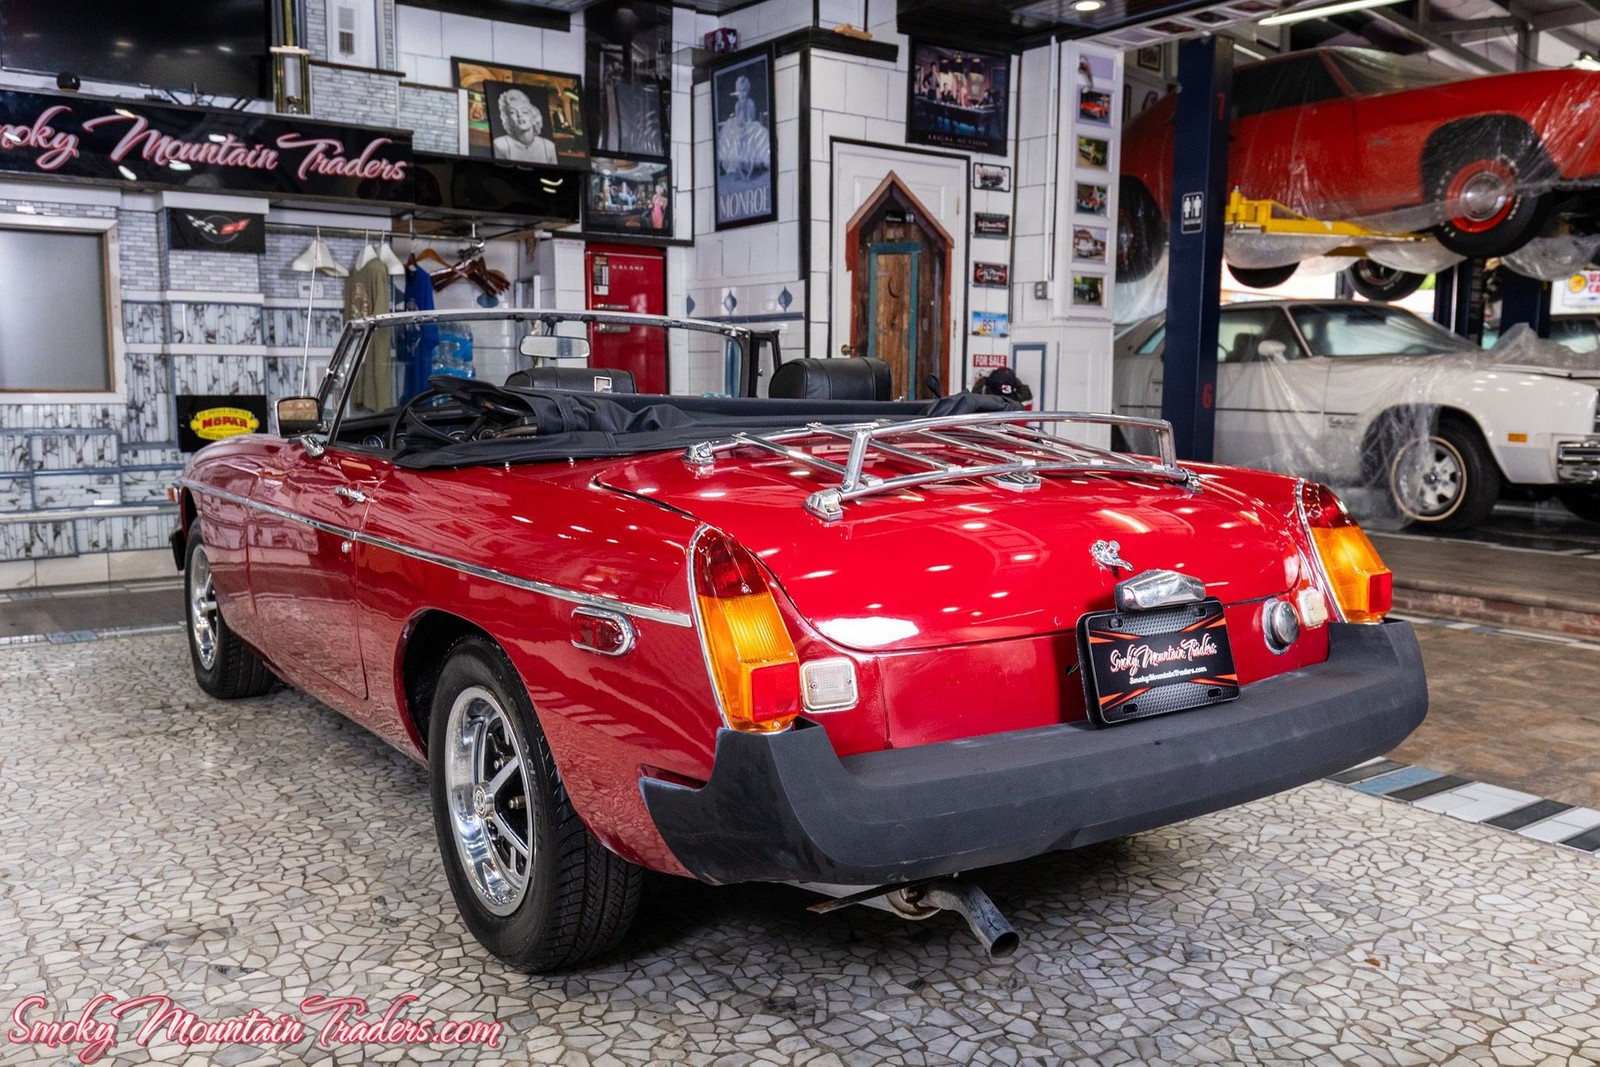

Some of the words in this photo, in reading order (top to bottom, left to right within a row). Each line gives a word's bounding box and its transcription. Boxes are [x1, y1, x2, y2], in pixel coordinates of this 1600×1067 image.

[82, 113, 279, 171] Mountain
[276, 133, 406, 180] Traders
[720, 187, 770, 218] MONROE
[975, 355, 988, 366] FOR
[989, 355, 1005, 367] SALE
[1001, 384, 1012, 394] 3
[1110, 643, 1140, 677] Smoky
[1134, 644, 1187, 669] Mountain
[1180, 633, 1217, 662] Traders
